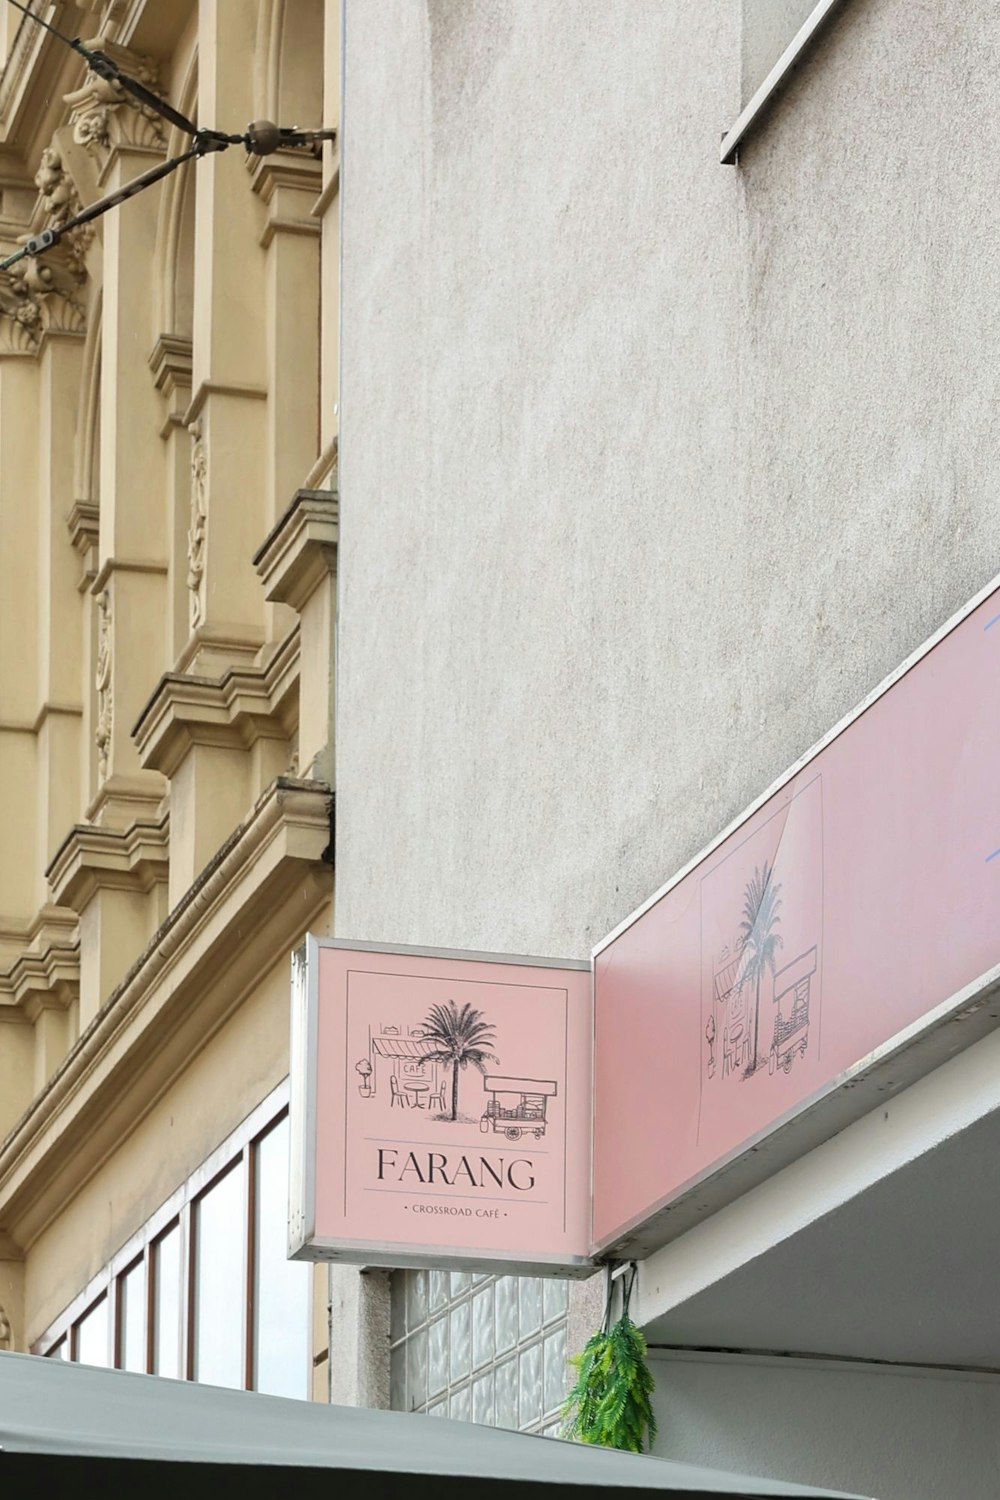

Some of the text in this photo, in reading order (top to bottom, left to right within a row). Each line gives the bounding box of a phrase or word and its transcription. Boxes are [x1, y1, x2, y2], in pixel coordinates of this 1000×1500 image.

[376, 1148, 535, 1191] FARANG
[412, 1204, 499, 1219] CROSSROAD CAFÉ
